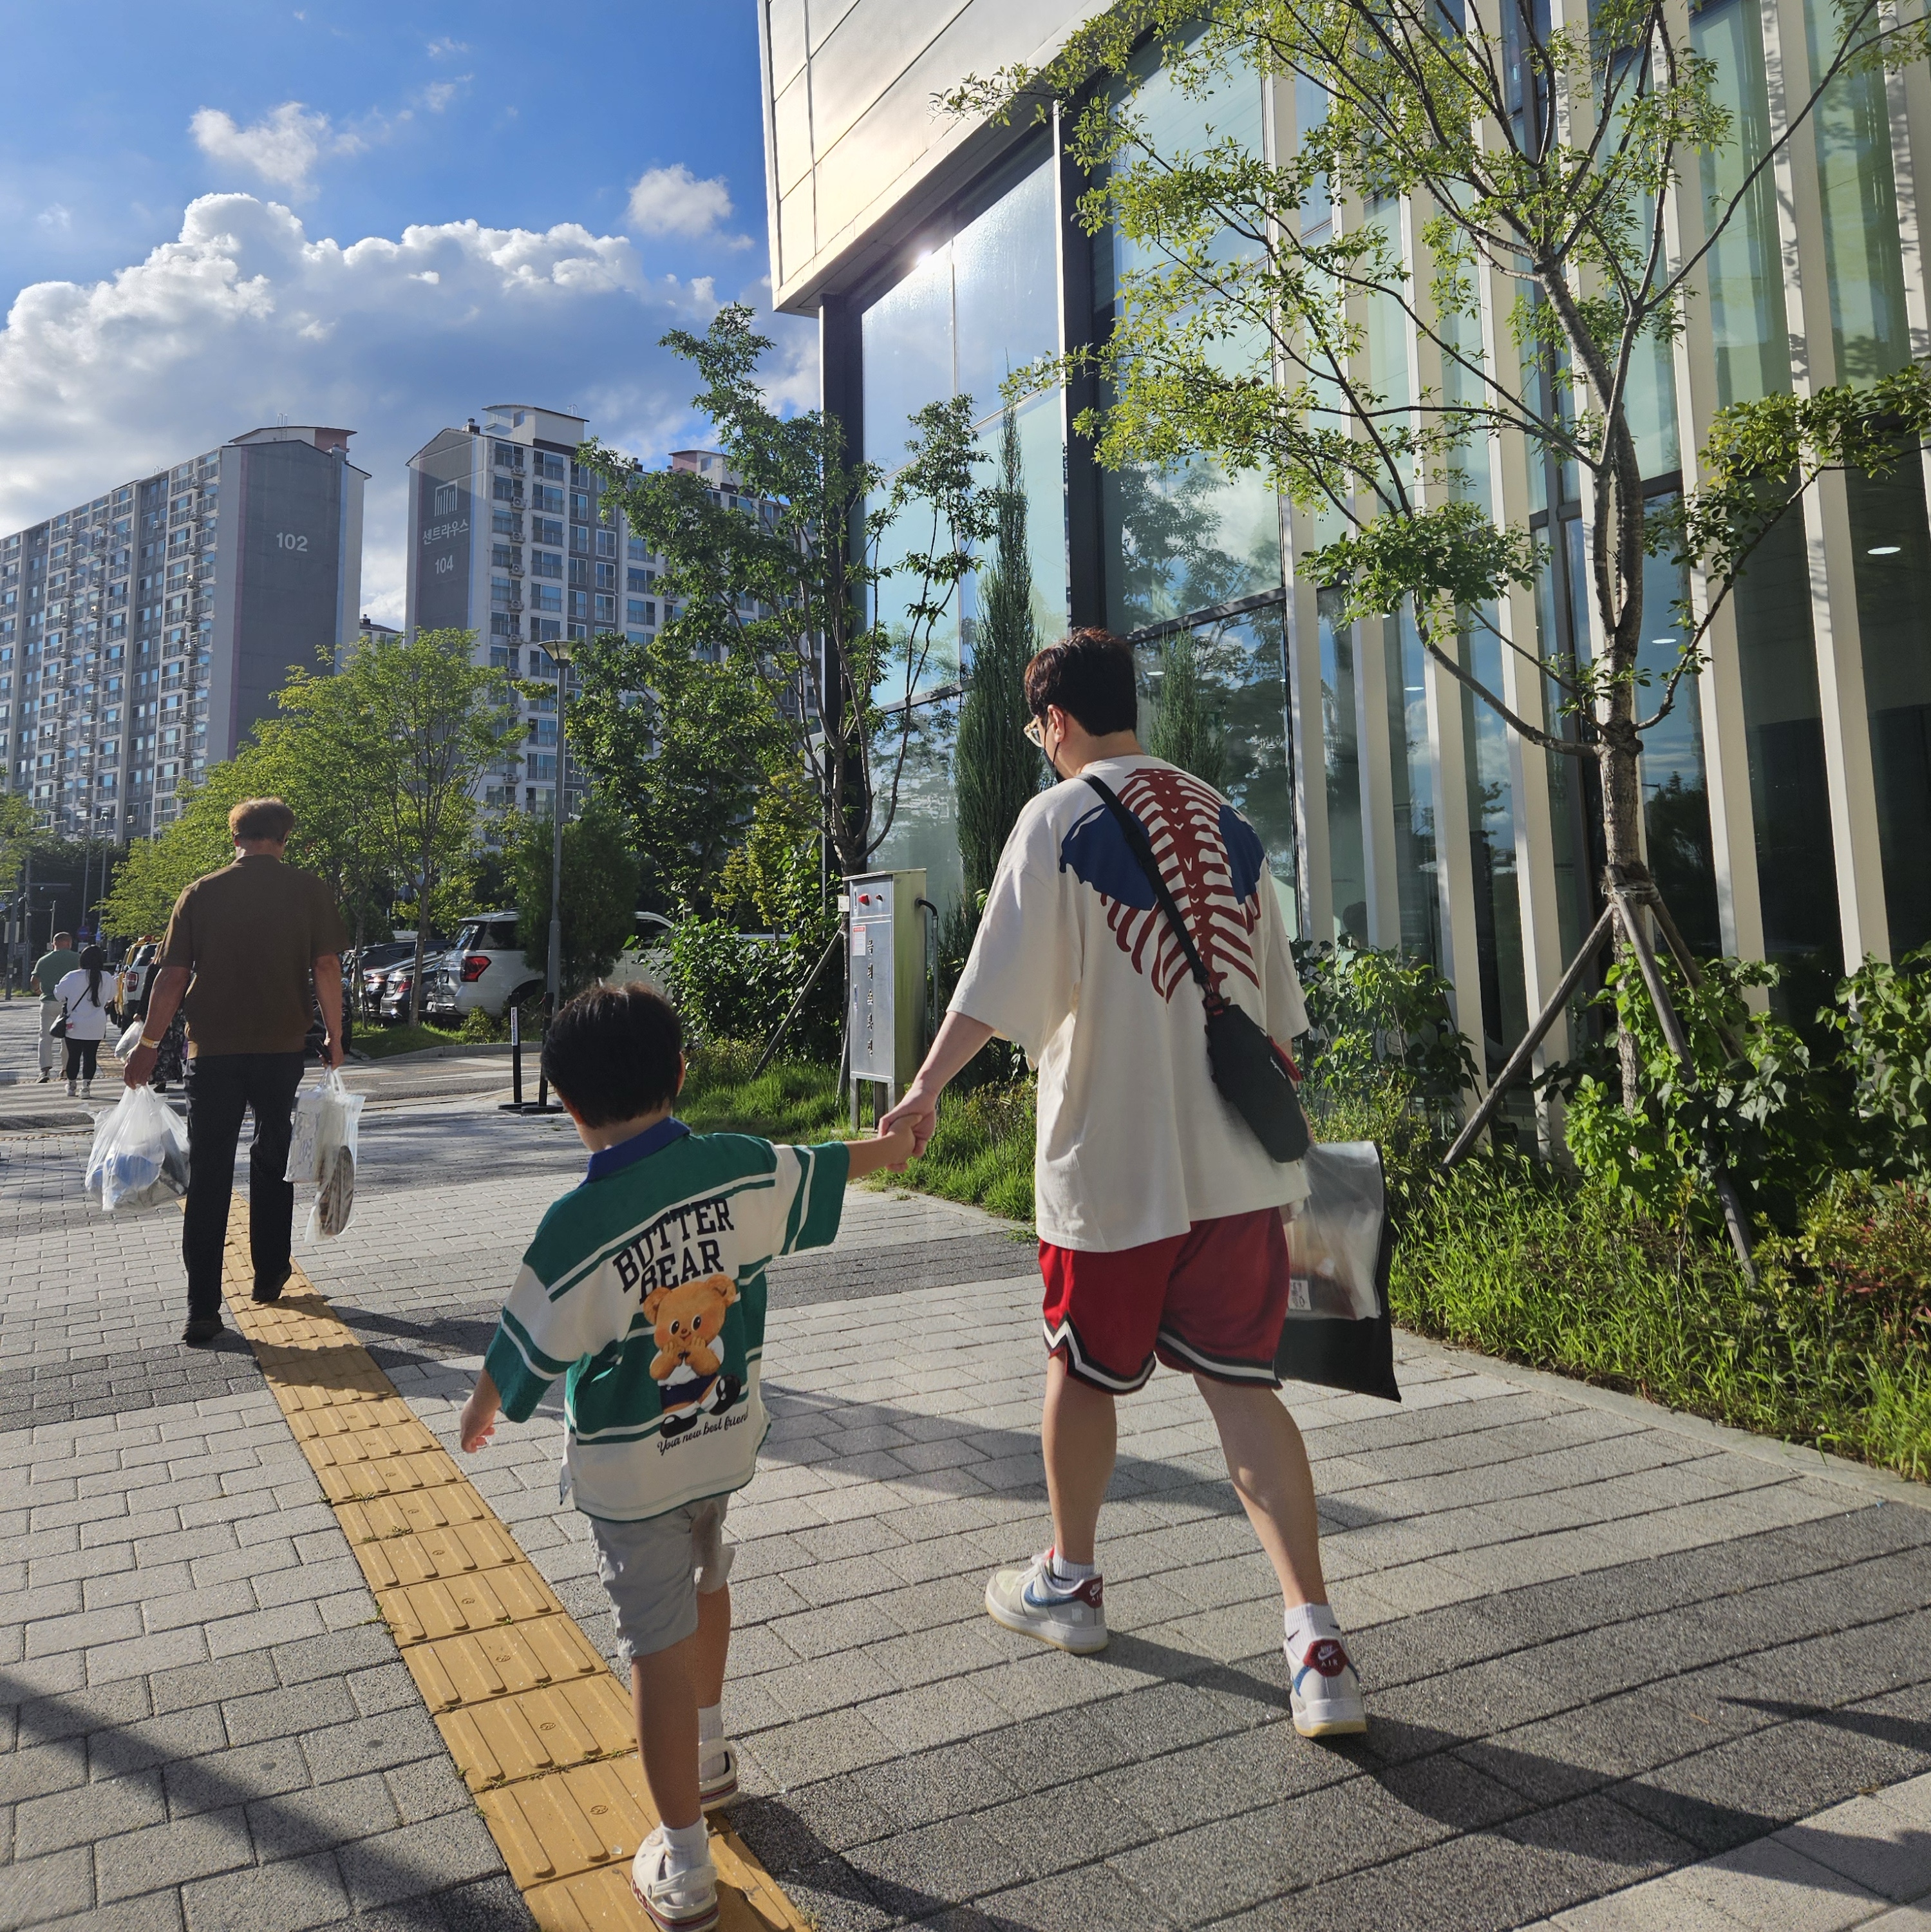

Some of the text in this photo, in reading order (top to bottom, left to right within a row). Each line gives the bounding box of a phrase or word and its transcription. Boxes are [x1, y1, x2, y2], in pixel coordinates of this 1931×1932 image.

[276, 532, 308, 552] 102
[422, 519, 469, 545] 센트라우스
[435, 555, 453, 574] 104
[612, 1198, 735, 1294] BUTTER
[639, 1239, 724, 1305] BEAR
[657, 1437, 681, 1456] Your
[683, 1430, 702, 1443] new
[703, 1417, 722, 1435] best
